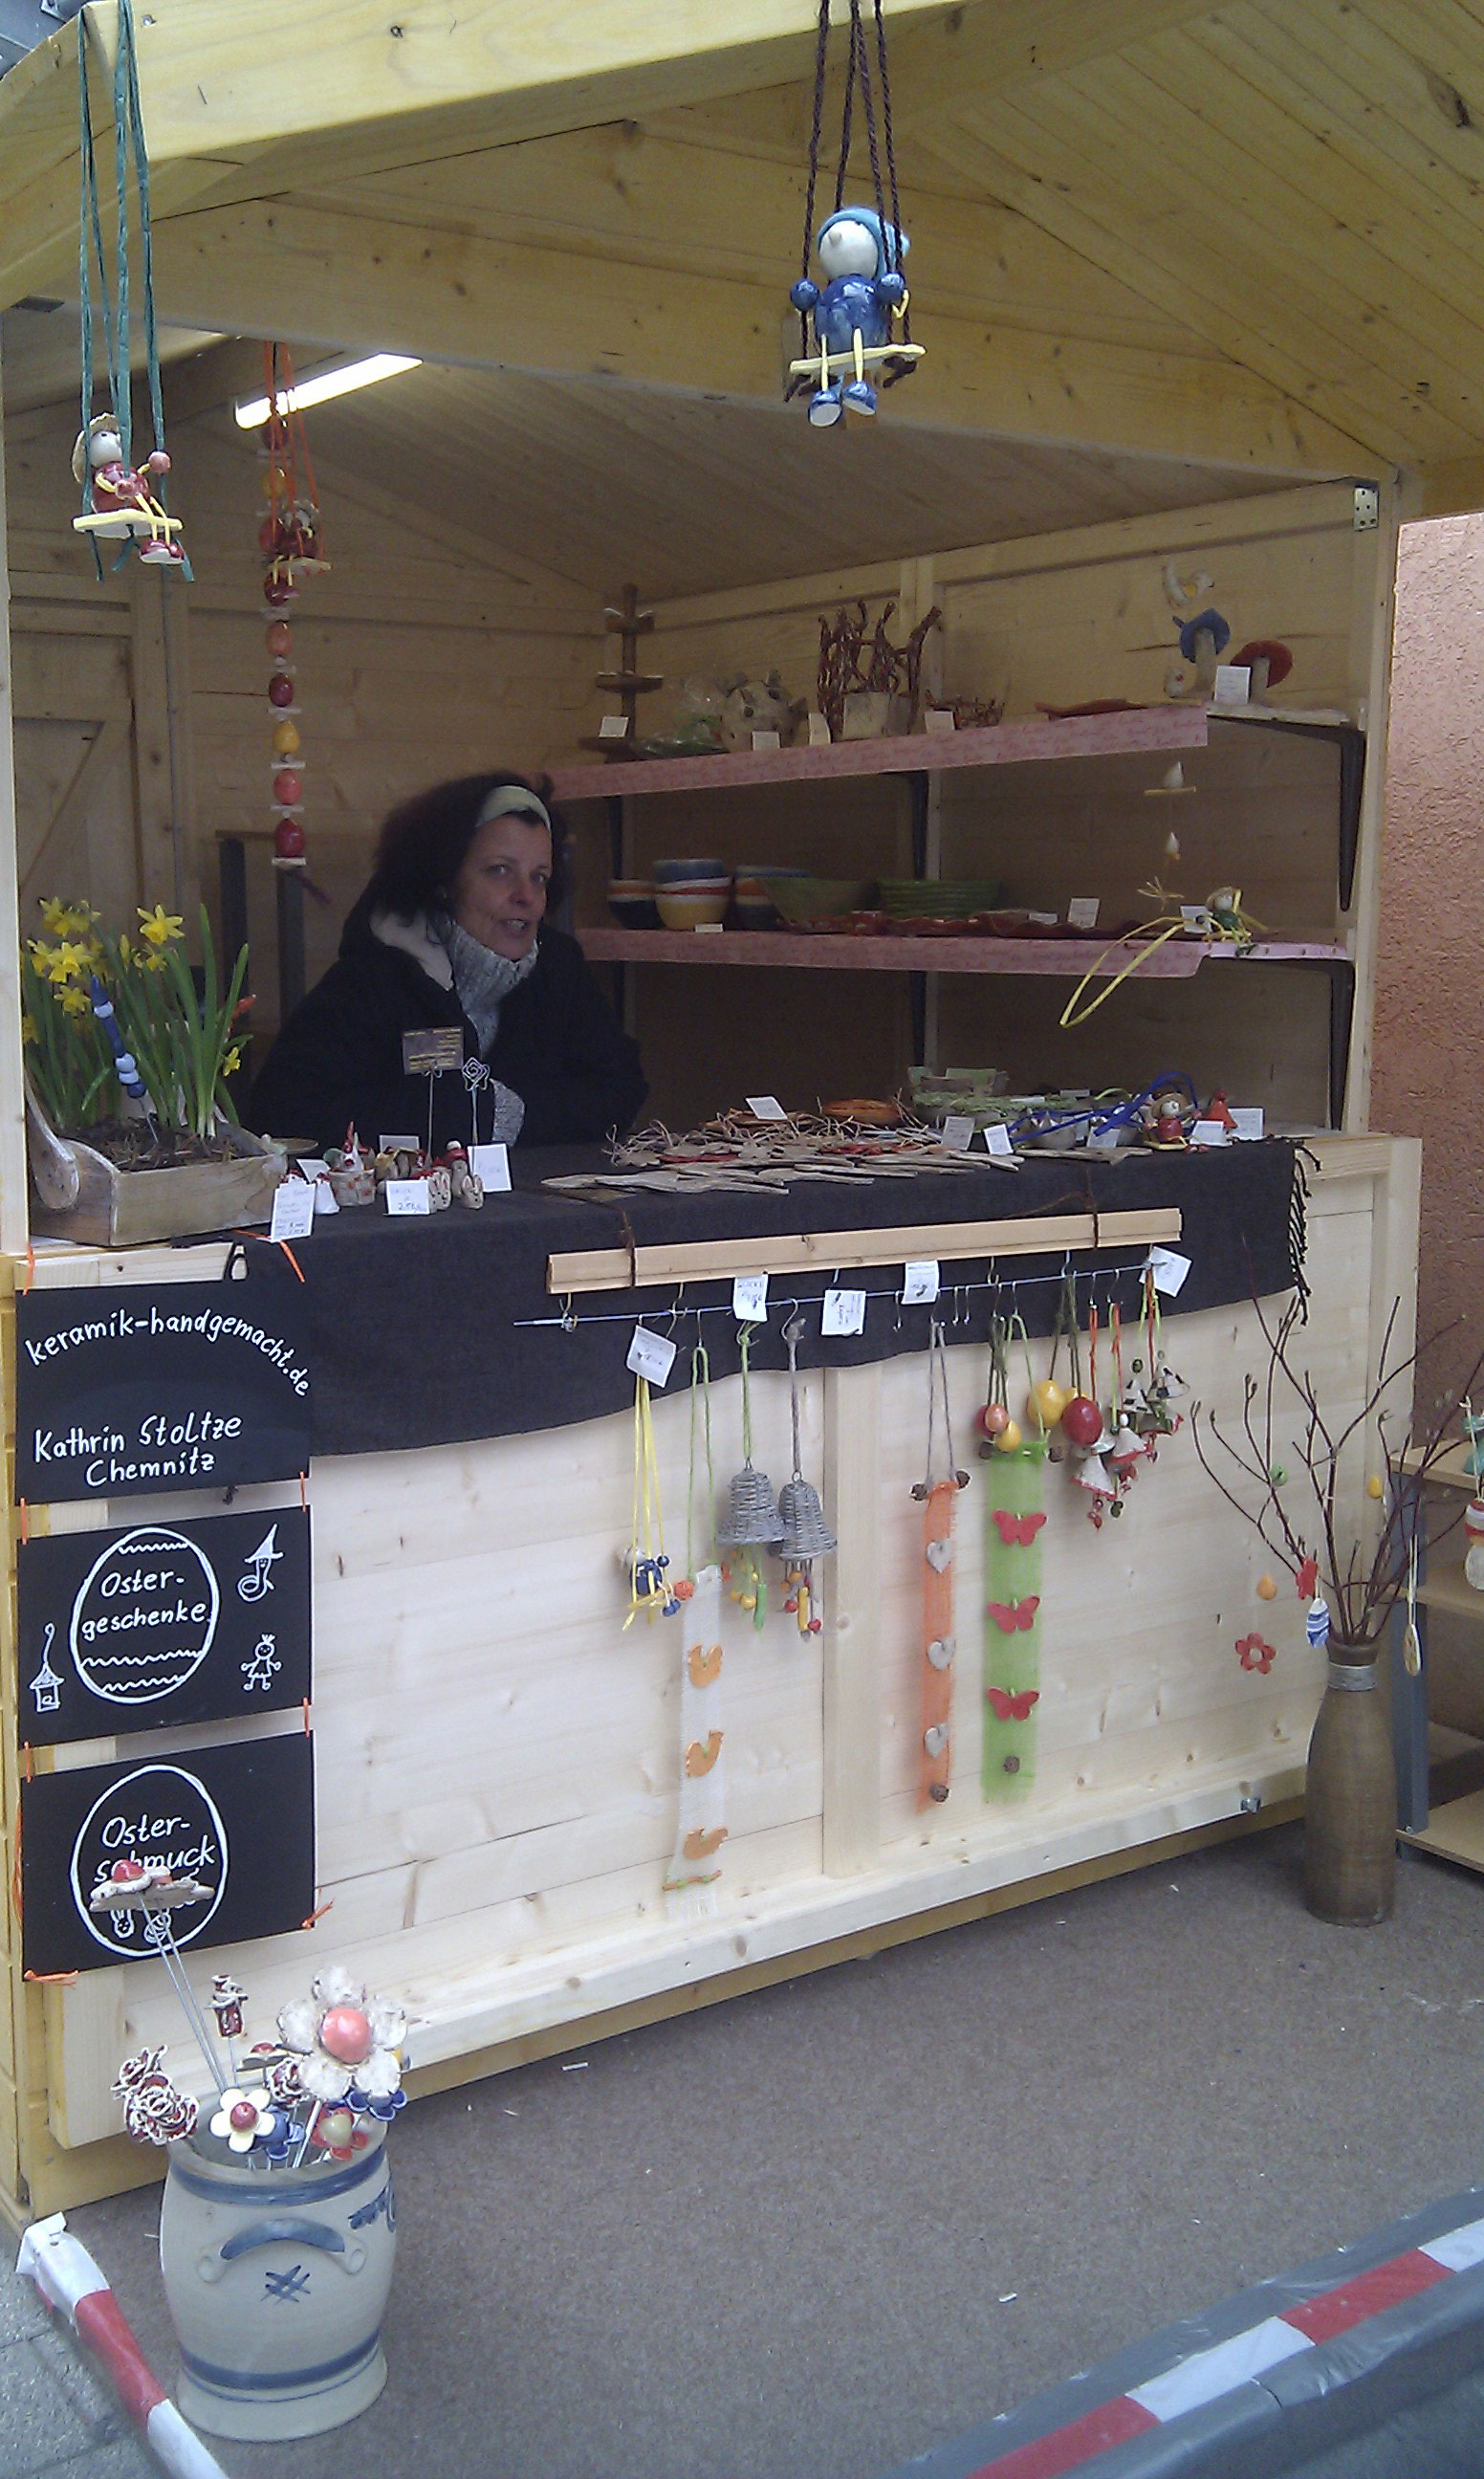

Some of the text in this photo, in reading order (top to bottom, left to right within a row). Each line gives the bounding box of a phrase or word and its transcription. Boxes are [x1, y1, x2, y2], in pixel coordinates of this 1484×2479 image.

[25, 1306, 309, 1396] keramik-handgemacht.de
[34, 1412, 241, 1462] Kathrin Stoltze
[86, 1447, 215, 1486] Chemnitz
[100, 1569, 185, 1597] Oster-
[81, 1600, 207, 1640] geschenke
[102, 1813, 190, 1848] Oster-
